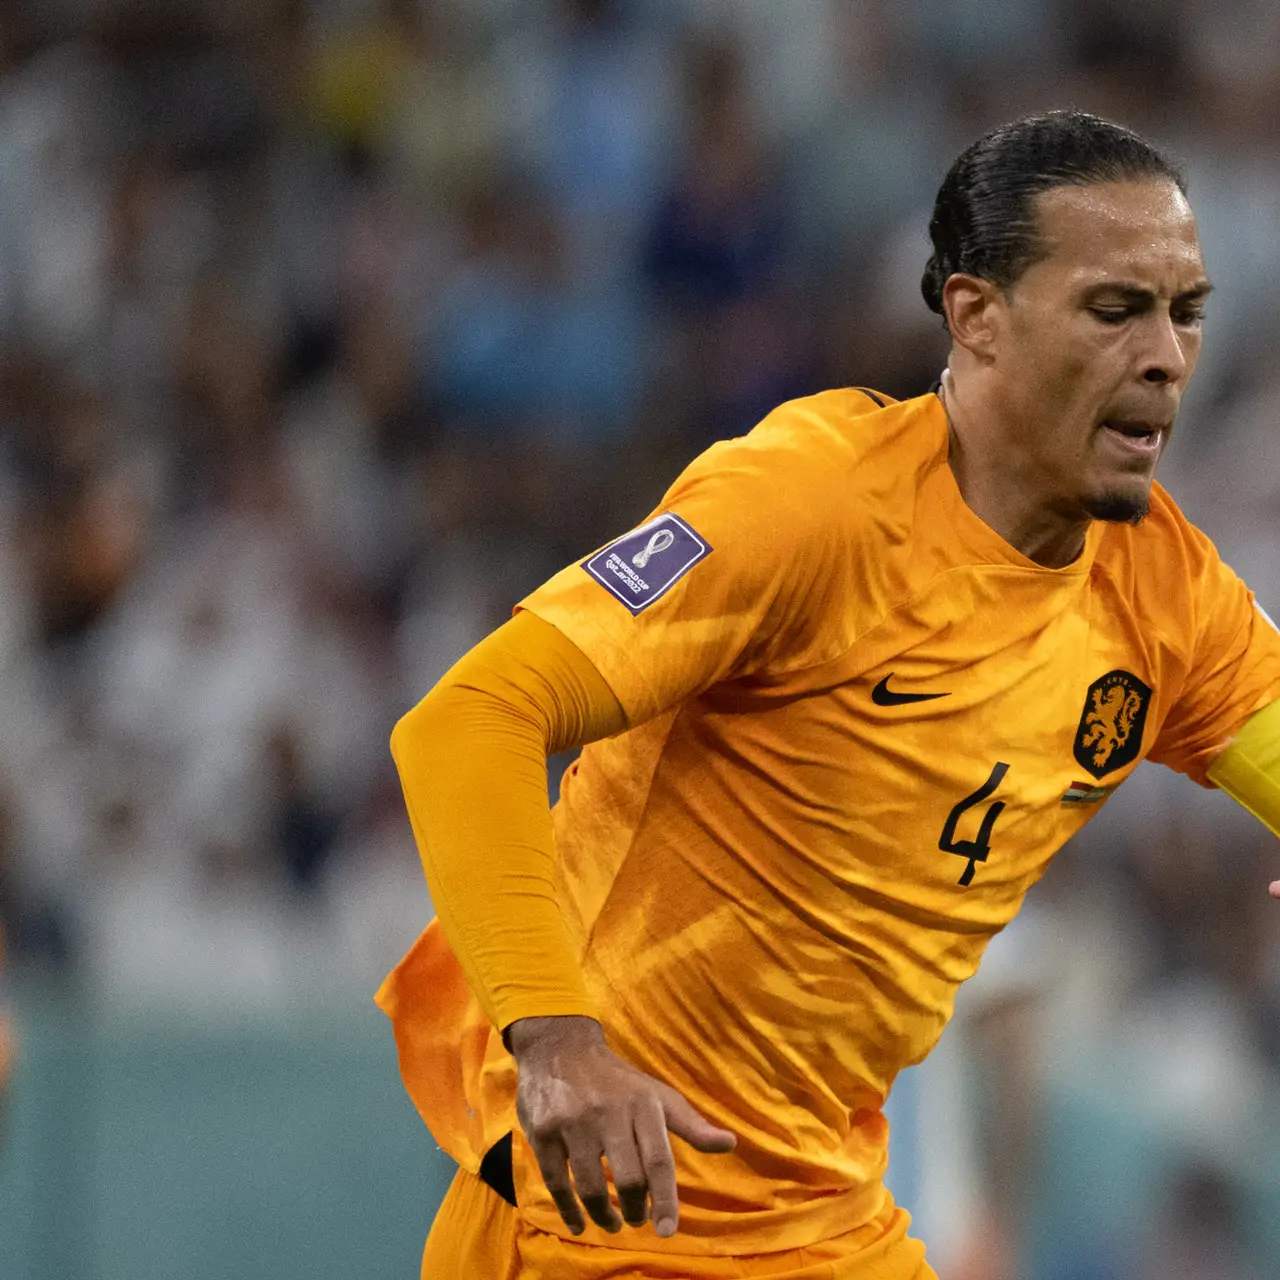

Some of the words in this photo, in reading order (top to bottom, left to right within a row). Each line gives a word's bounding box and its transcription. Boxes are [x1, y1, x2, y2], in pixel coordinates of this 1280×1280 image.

[609, 553, 621, 565] FIFA
[620, 561, 639, 581] WORLD
[637, 579, 650, 590] CUP
[938, 761, 1011, 887] 4
